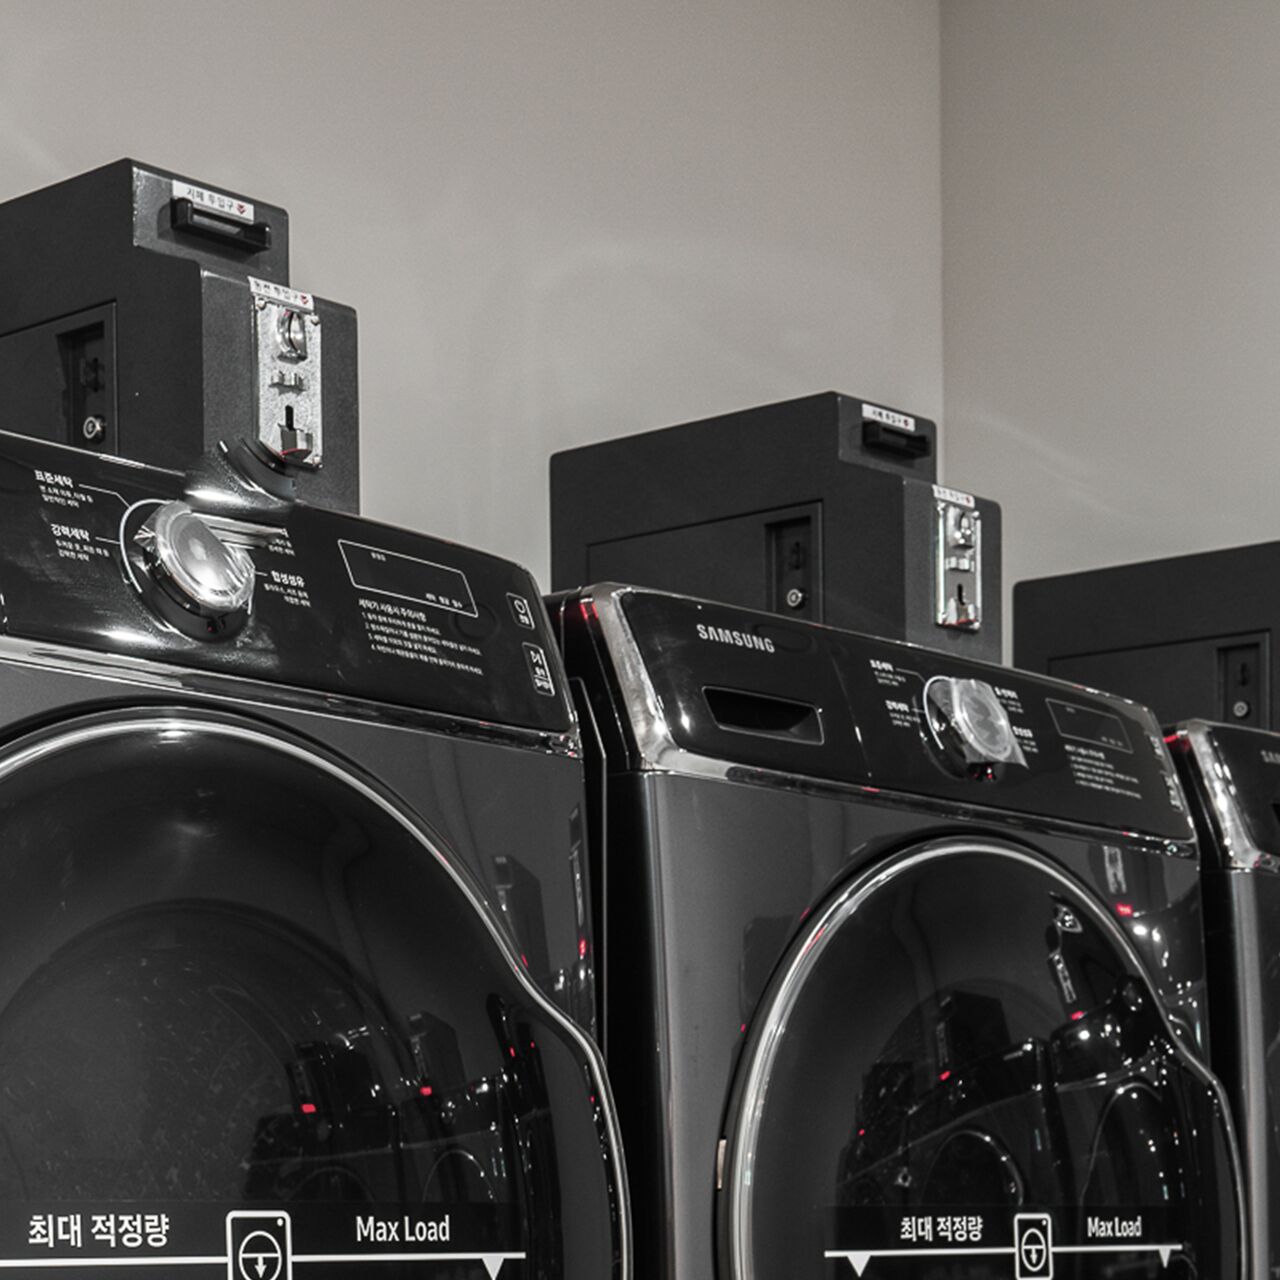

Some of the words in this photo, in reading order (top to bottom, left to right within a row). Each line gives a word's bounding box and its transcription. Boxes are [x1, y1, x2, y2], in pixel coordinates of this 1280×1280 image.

[696, 623, 775, 654] SAMSUNG
[28, 1215, 83, 1249] 최대
[91, 1214, 170, 1248] 적정량
[356, 1216, 400, 1243] Max
[404, 1215, 450, 1242] Load
[900, 1217, 933, 1242] 최대
[936, 1216, 983, 1242] 적정량
[1087, 1217, 1114, 1237] Max
[1114, 1216, 1142, 1237] Load
